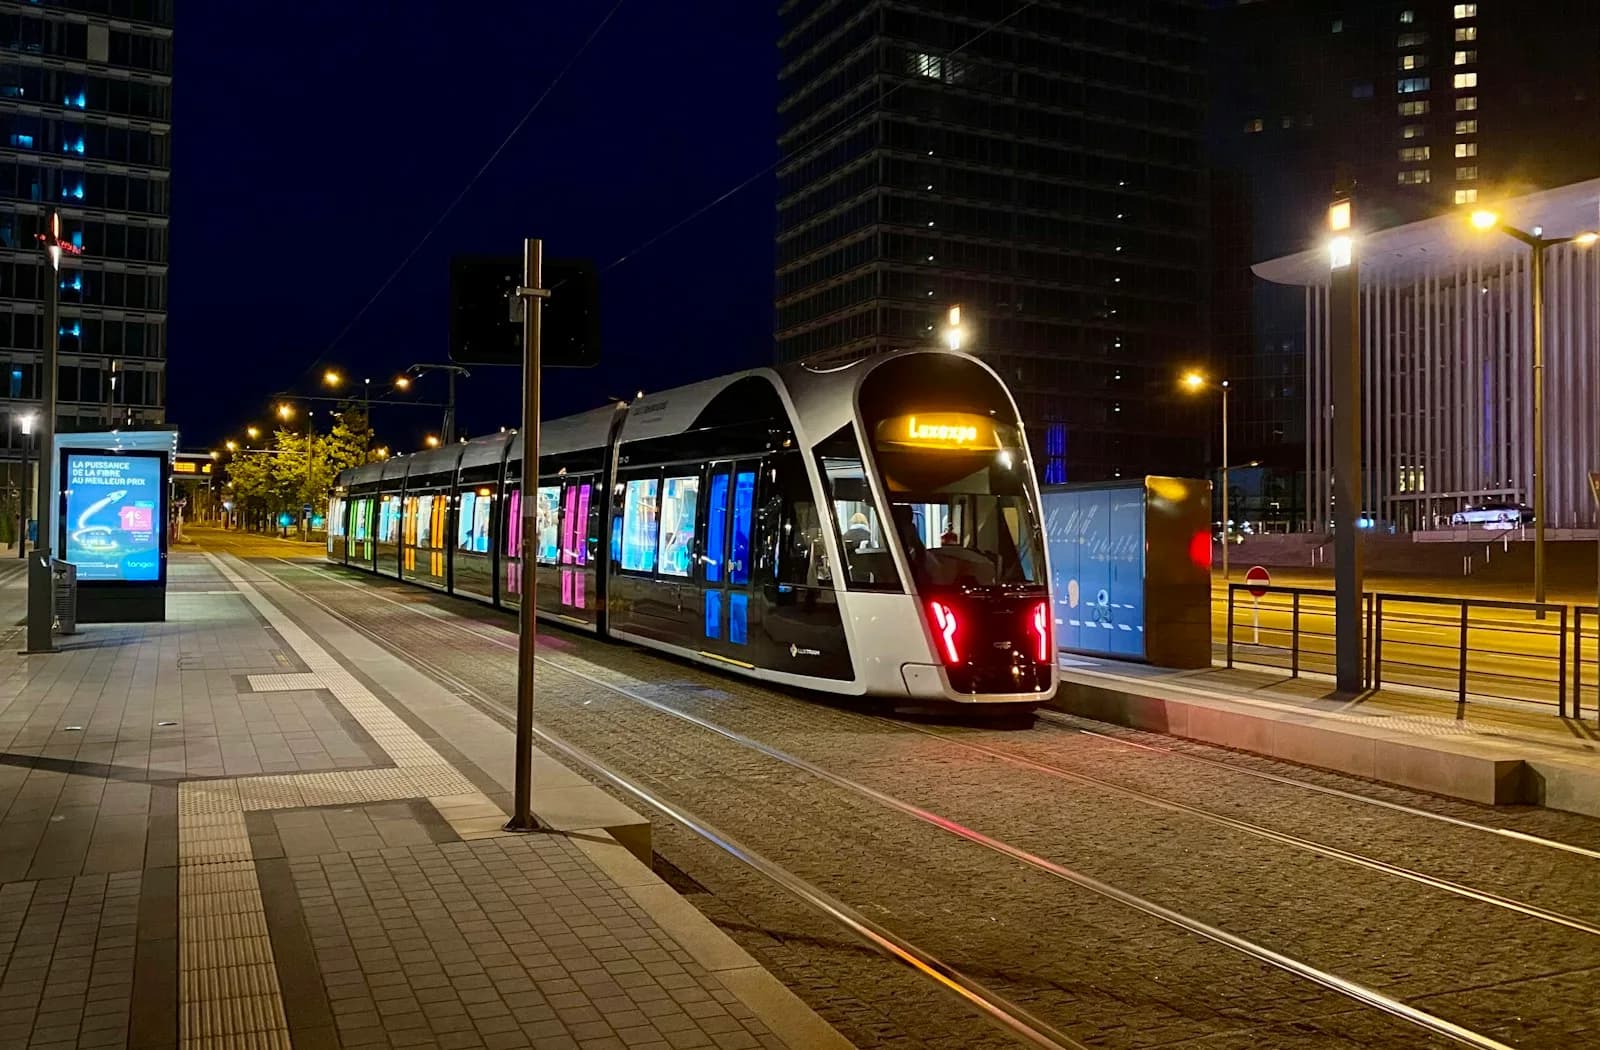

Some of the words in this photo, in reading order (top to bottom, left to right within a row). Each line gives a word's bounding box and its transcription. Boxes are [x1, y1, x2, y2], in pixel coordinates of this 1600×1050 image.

[909, 416, 977, 444] Luxexpo
[85, 477, 125, 485] MEILLEUR
[127, 560, 153, 568] tango
